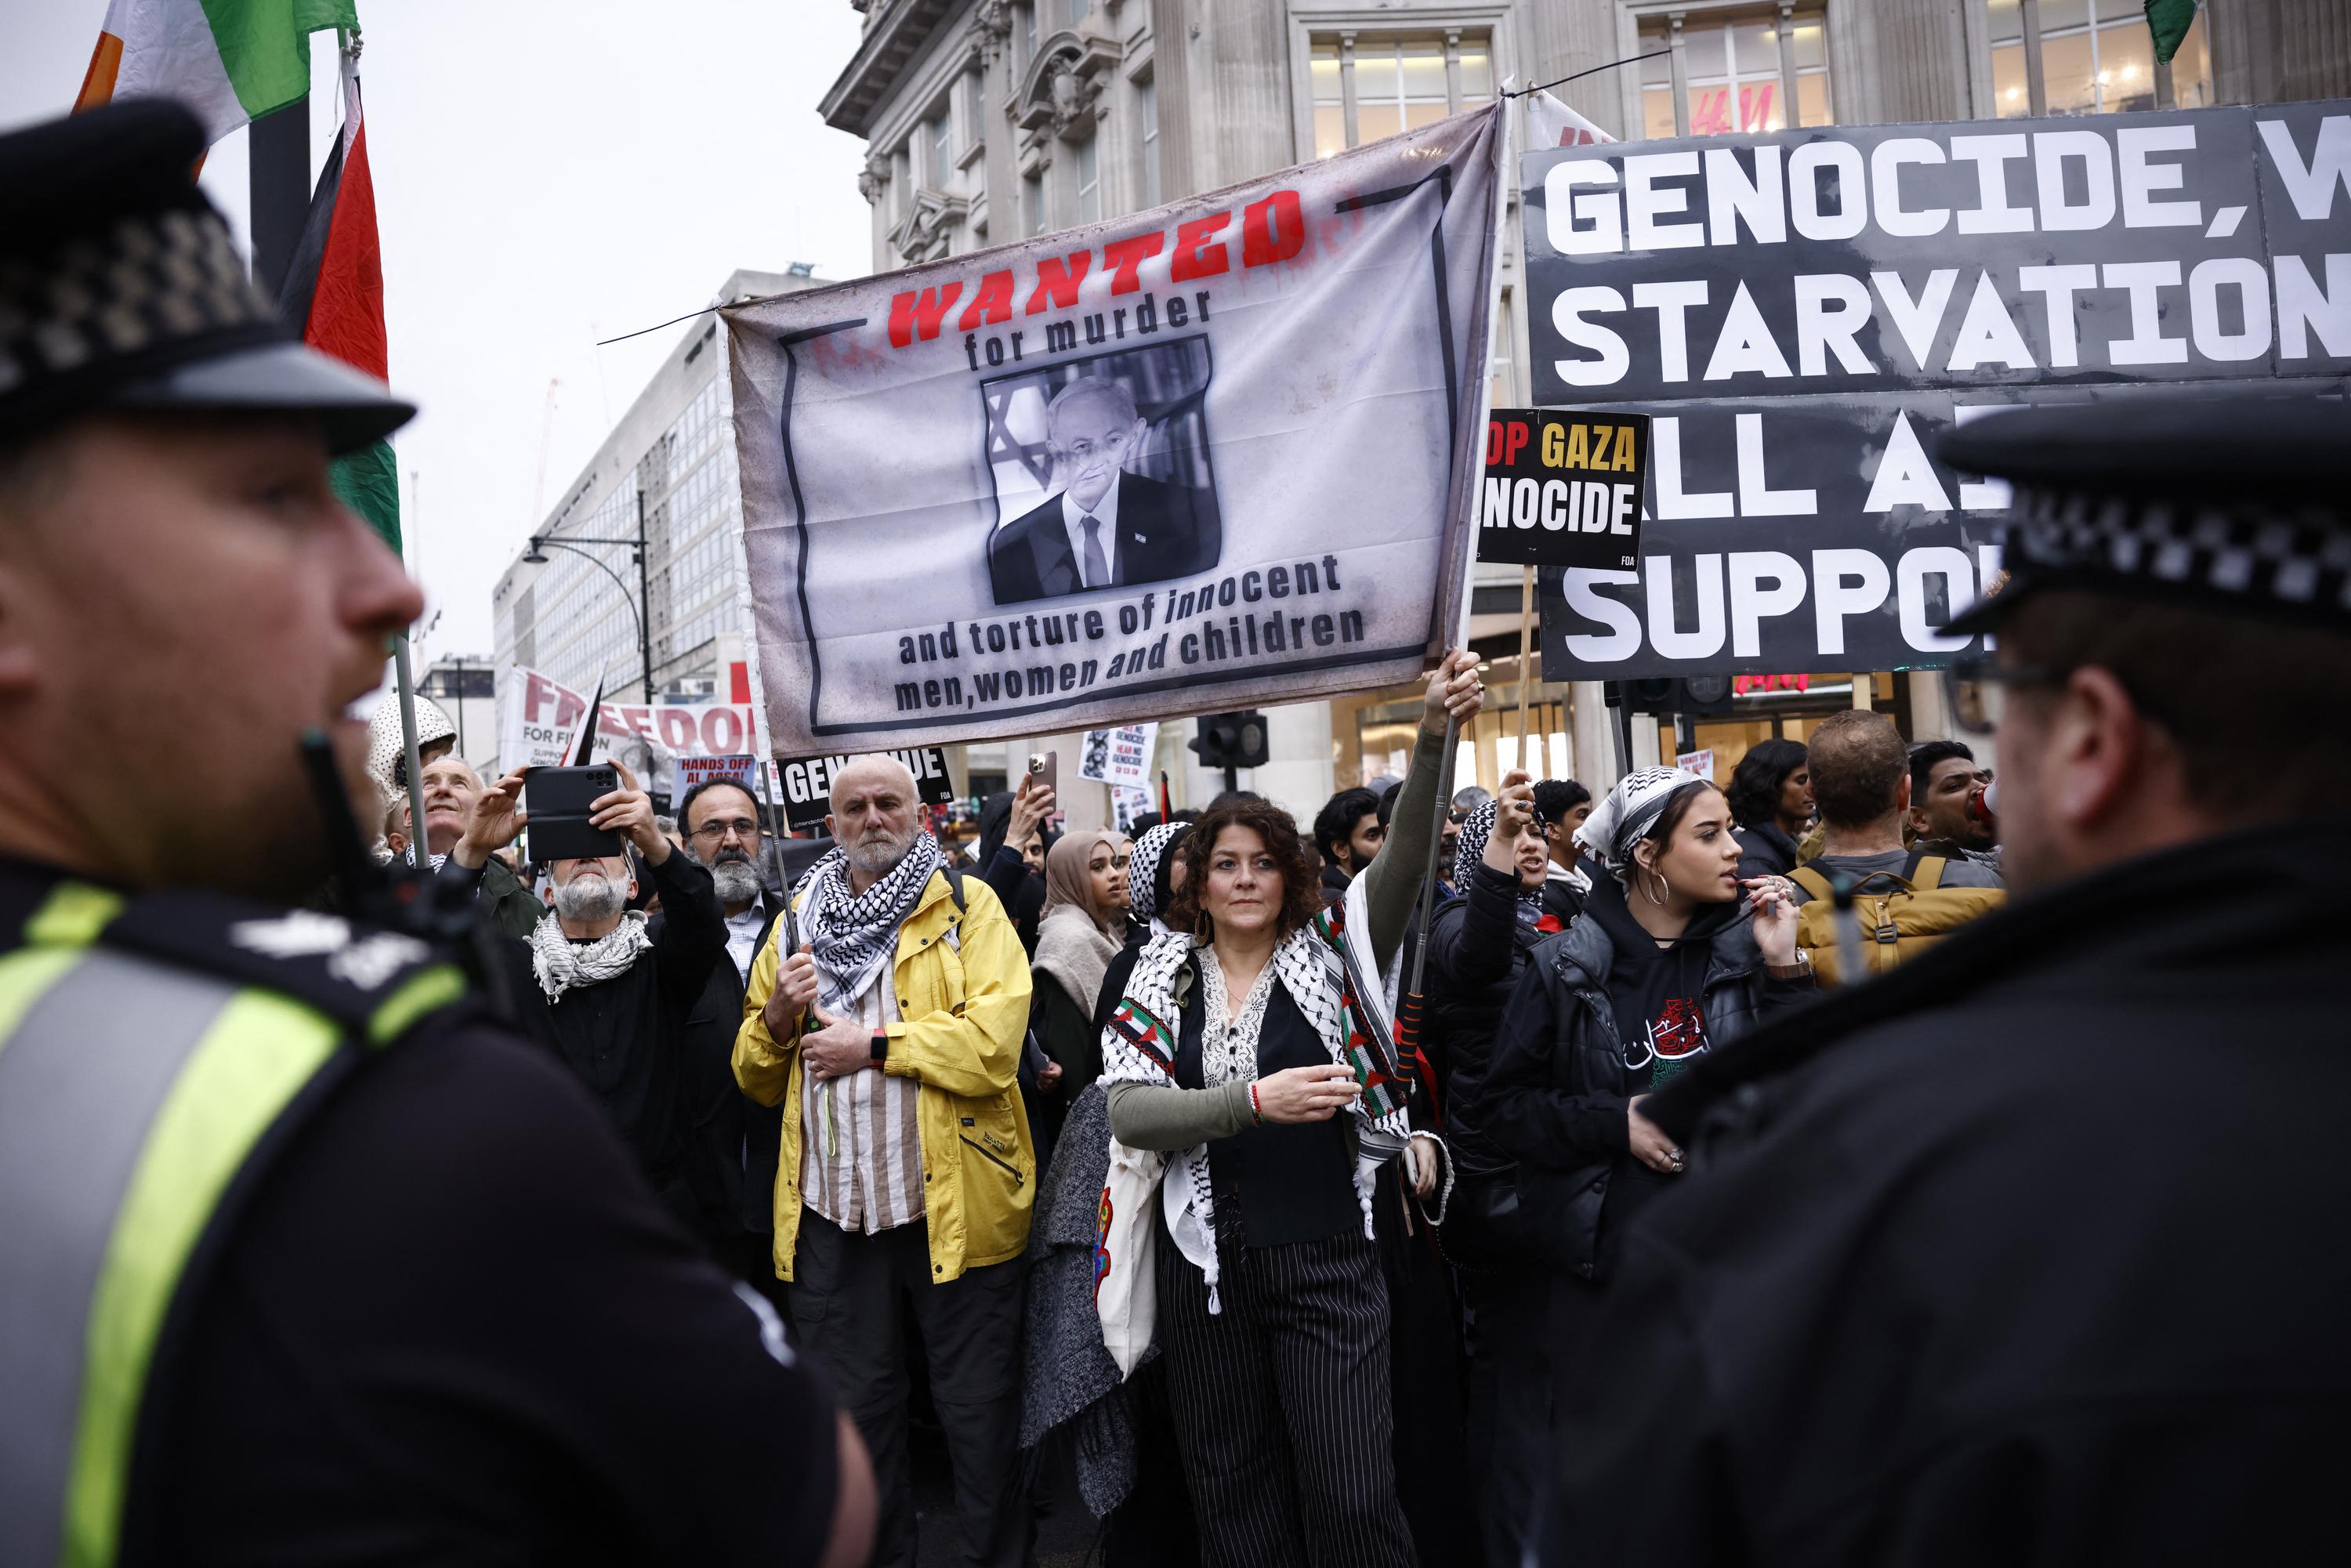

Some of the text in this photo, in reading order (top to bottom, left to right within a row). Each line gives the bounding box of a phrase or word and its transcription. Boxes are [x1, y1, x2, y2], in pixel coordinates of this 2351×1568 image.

[1545, 125, 2248, 255] GENOCIDE,
[887, 190, 1306, 349] WANTED
[965, 288, 1211, 371] for murder
[1552, 253, 2351, 386] STARVATION
[1485, 421, 1636, 472] OP GAZA
[1643, 413, 1818, 520] LL
[1483, 477, 1635, 535] NOCIDE
[1621, 556, 1635, 567] FOA
[899, 555, 1342, 664] and torture of innocent
[1563, 545, 2003, 663] SUPPO
[1107, 633, 1168, 680] and
[1181, 608, 1365, 665] children
[523, 726, 556, 744] FOR
[524, 672, 758, 755] FREEDO
[681, 758, 752, 771] HANDS OFF
[686, 772, 701, 784] AL
[940, 791, 951, 800] FOA
